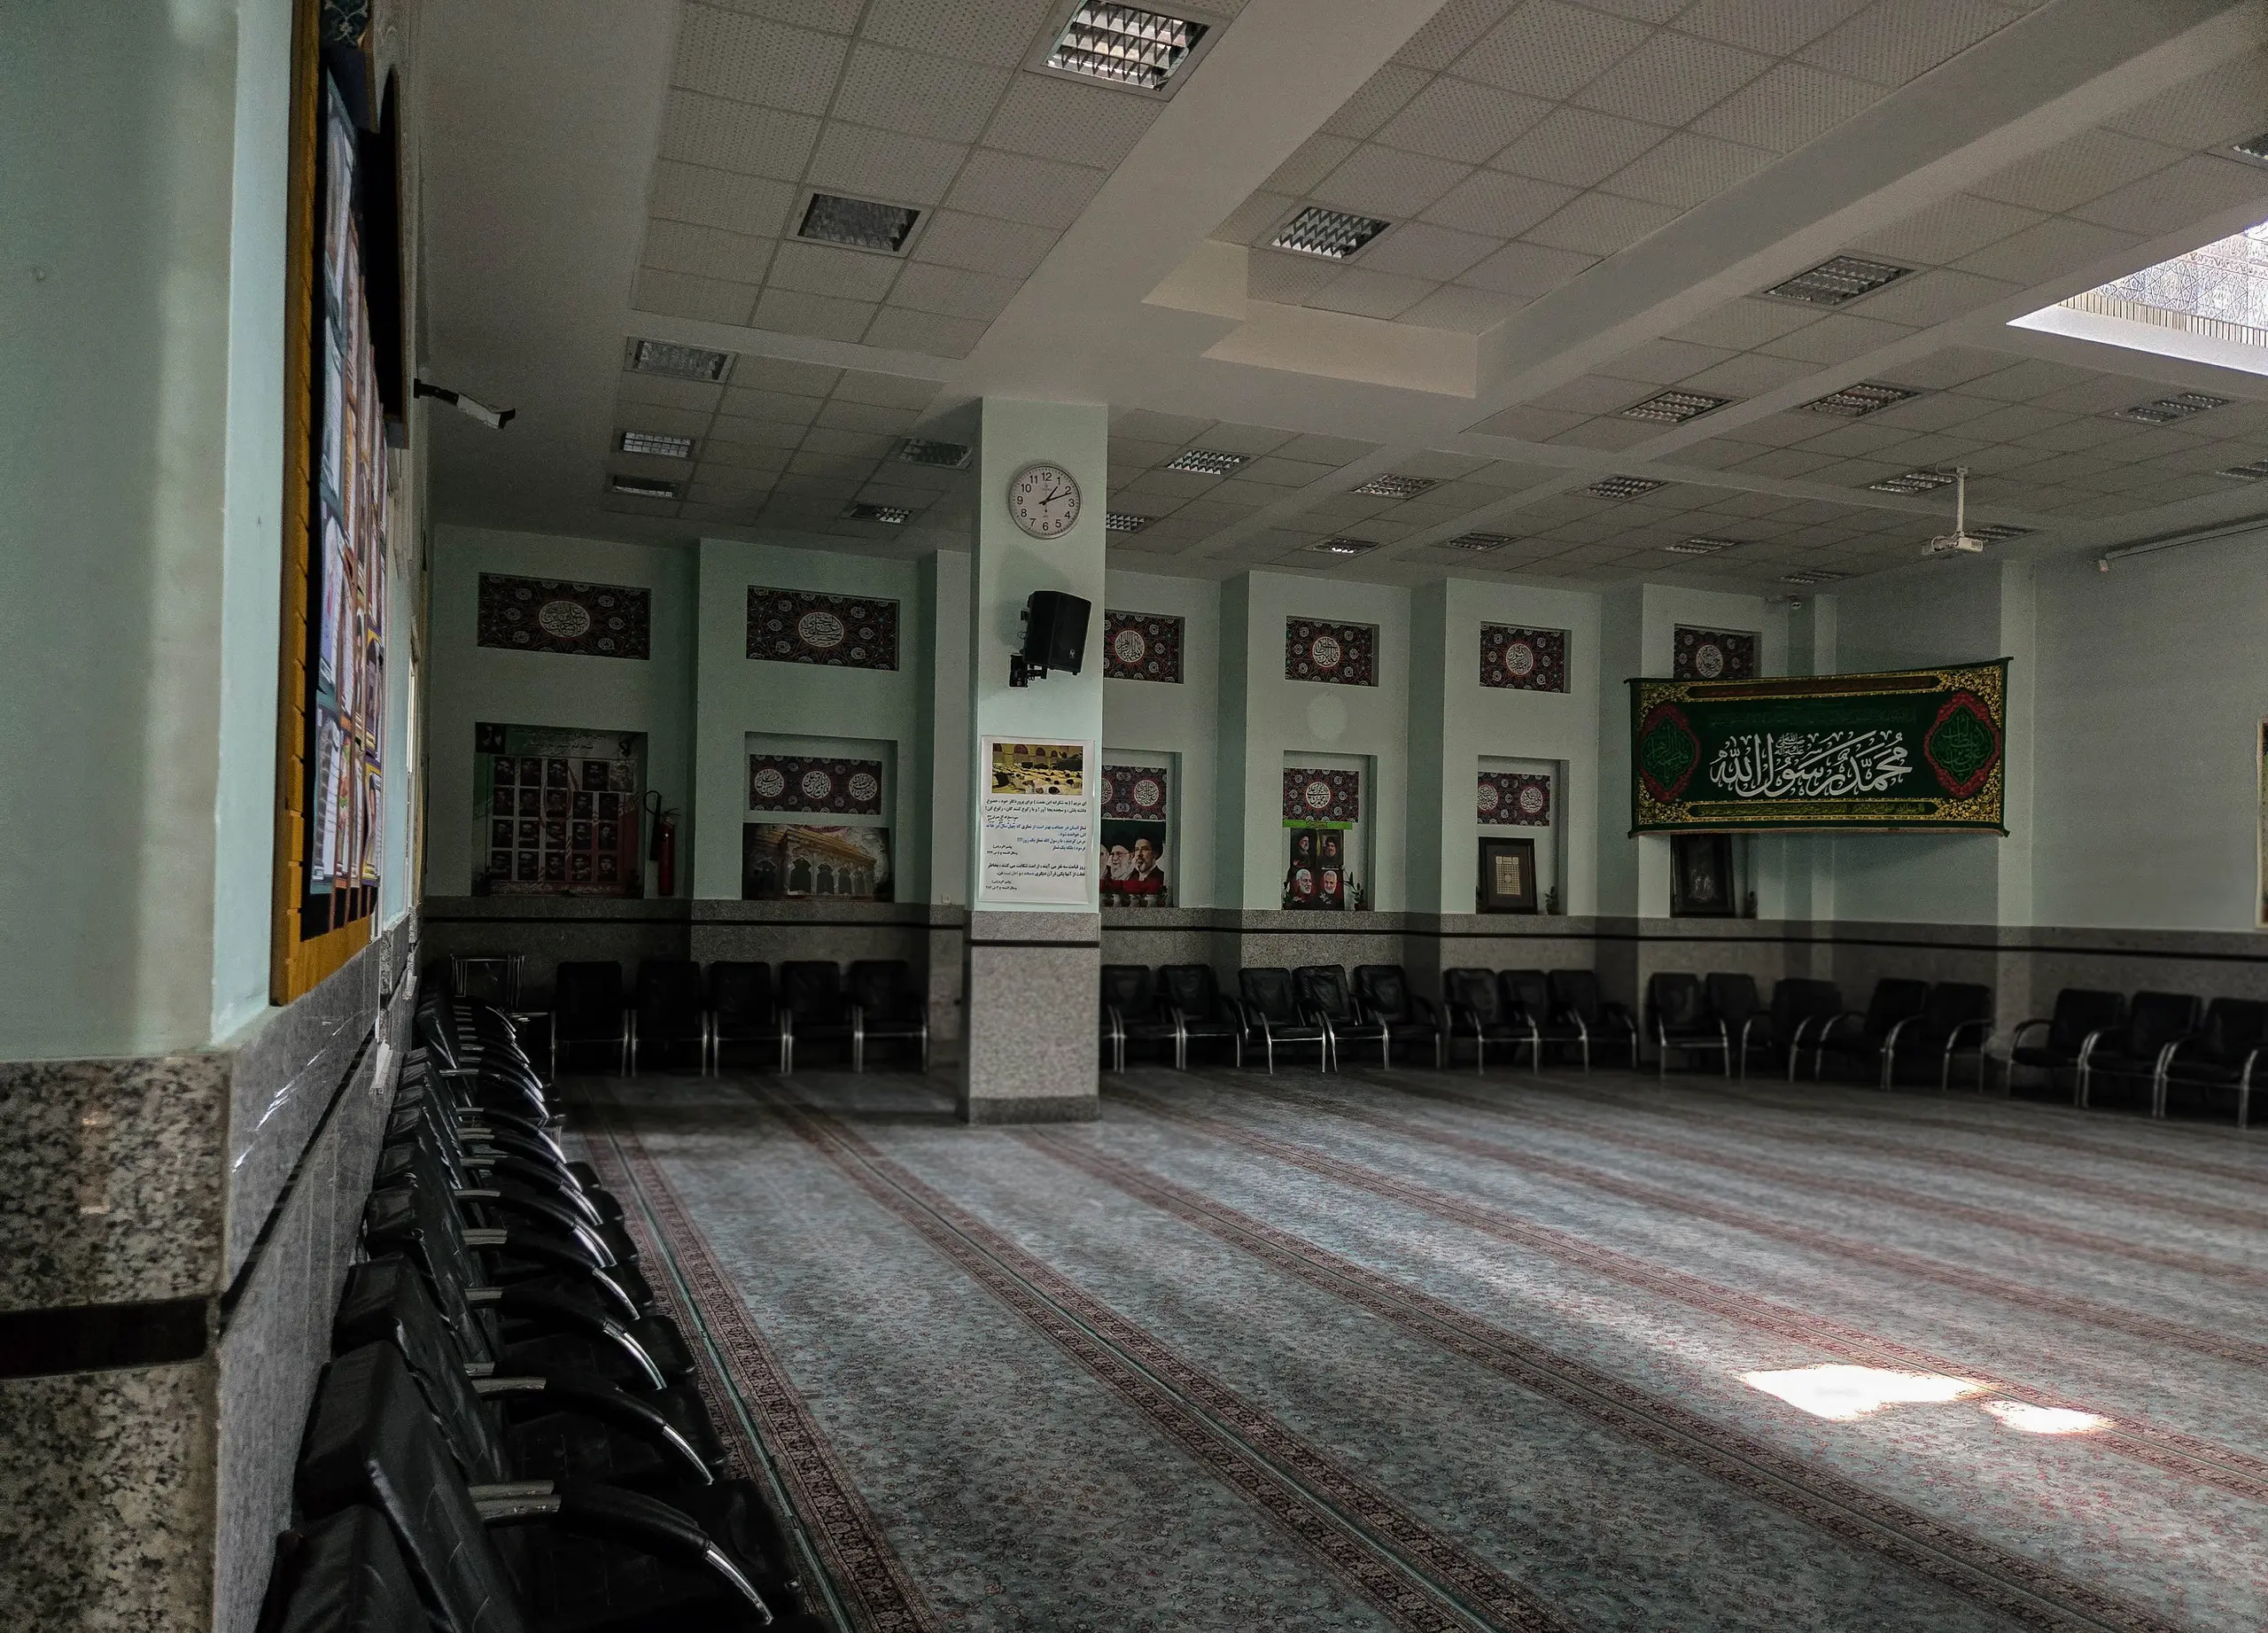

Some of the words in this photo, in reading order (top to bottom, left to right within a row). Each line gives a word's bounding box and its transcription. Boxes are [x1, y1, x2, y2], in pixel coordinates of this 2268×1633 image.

[1029, 475, 1038, 484] 11
[1042, 472, 1052, 481] 12
[1021, 484, 1031, 493] 10
[1017, 496, 1023, 505] 9
[1068, 498, 1075, 507] 3
[1021, 509, 1027, 517] 8
[1065, 510, 1070, 519] 4
[1043, 522, 1049, 531] 6
[1055, 519, 1061, 528] 5
